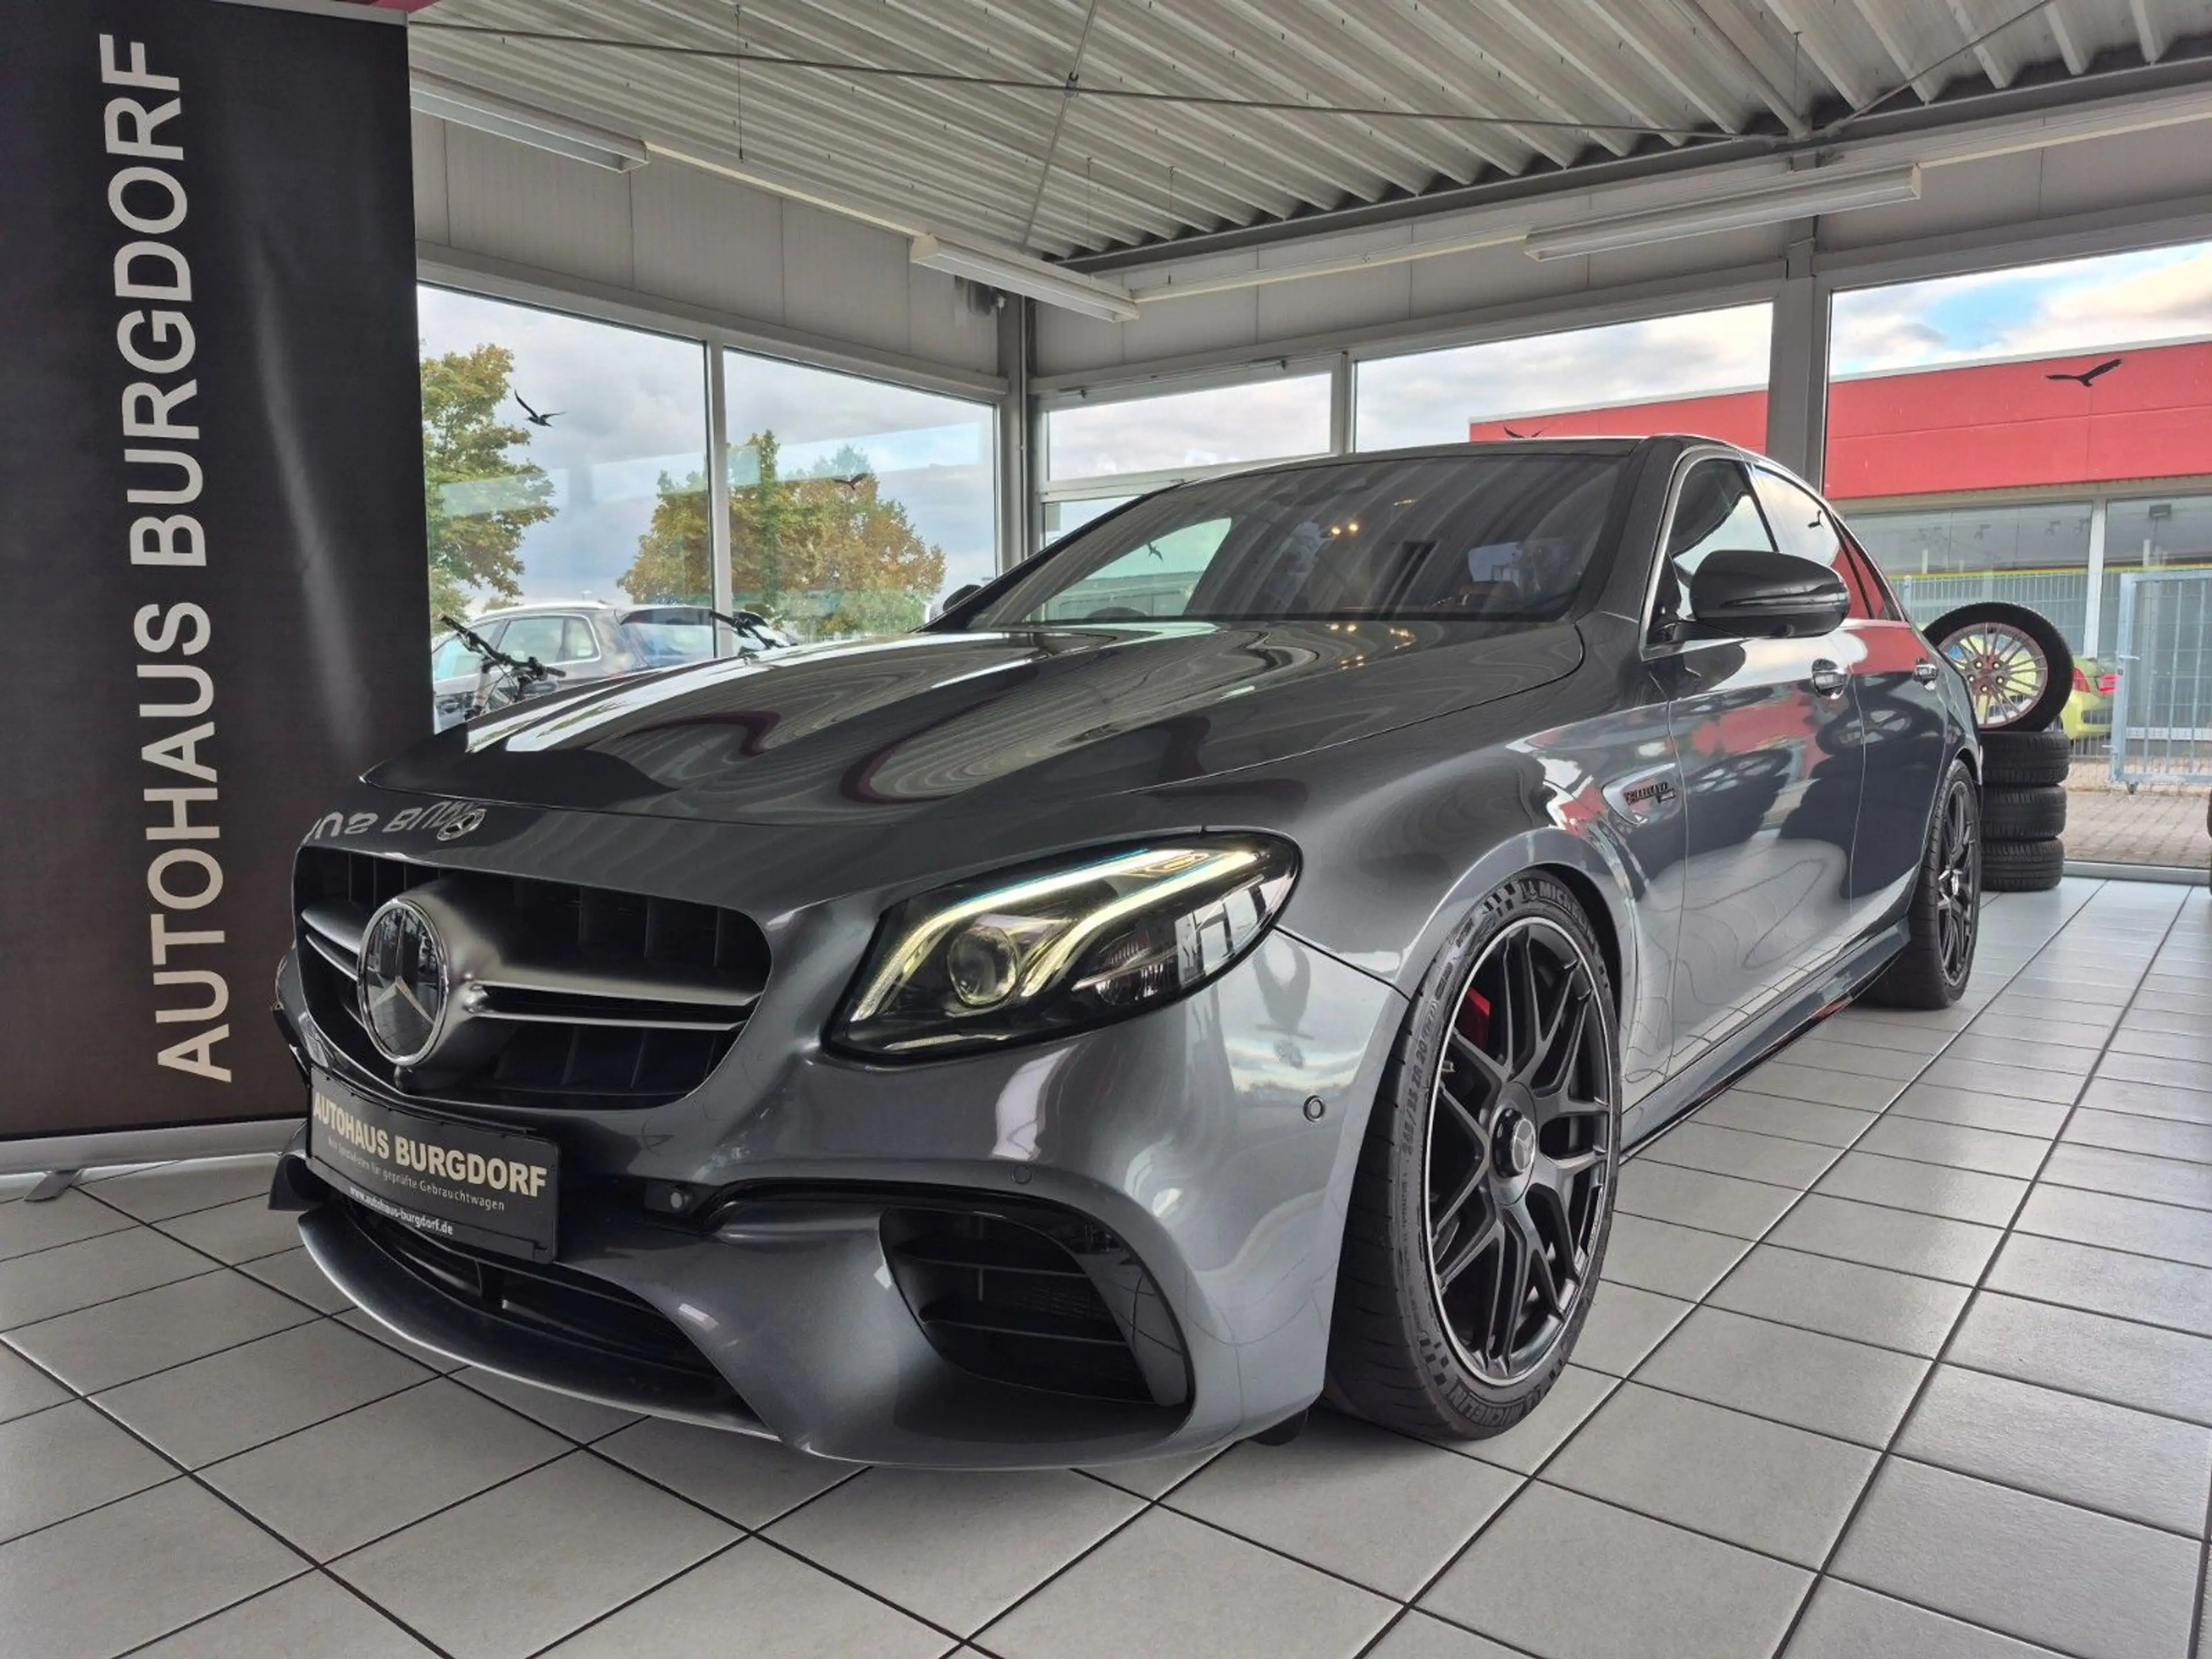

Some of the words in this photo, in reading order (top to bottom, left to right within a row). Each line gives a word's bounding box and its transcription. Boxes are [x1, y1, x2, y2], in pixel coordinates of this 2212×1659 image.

[99, 33, 207, 567] BURGDORF
[133, 602, 232, 1083] AUTOHAUS
[313, 1092, 389, 1160] AUTOHAUS
[395, 1135, 548, 1198] BURGDORF
[419, 1181, 505, 1211] Gebrauchtwagen
[349, 1186, 454, 1235] www.autohaus-burgdorf.de
